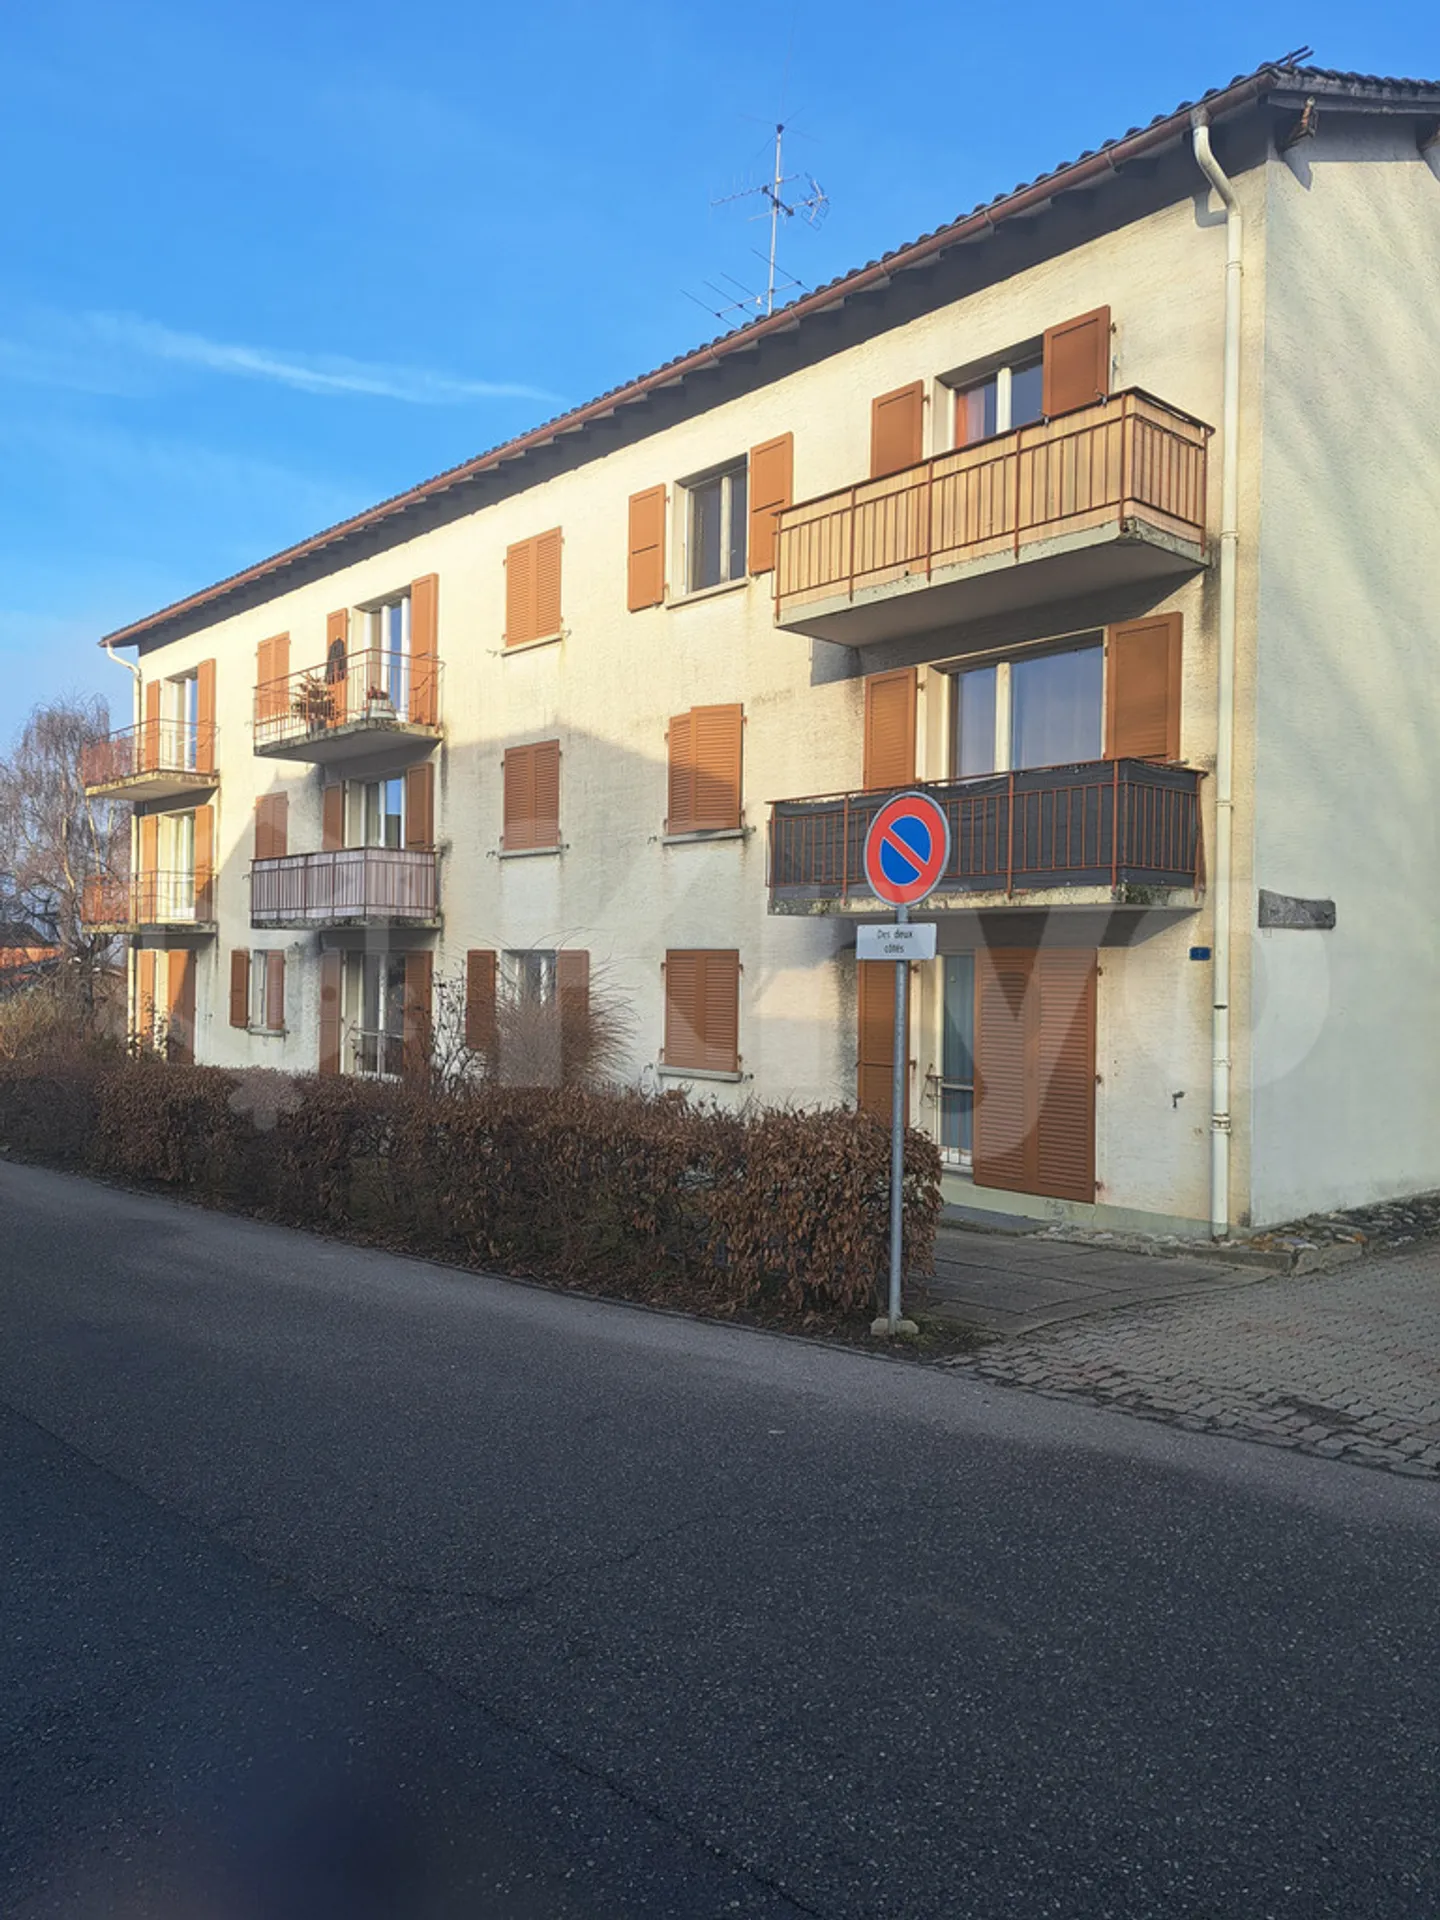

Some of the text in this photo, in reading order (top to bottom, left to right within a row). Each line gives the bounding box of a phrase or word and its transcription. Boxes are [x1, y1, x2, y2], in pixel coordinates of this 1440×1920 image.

[877, 928, 913, 939] Des deux
[883, 944, 905, 953] côtés
